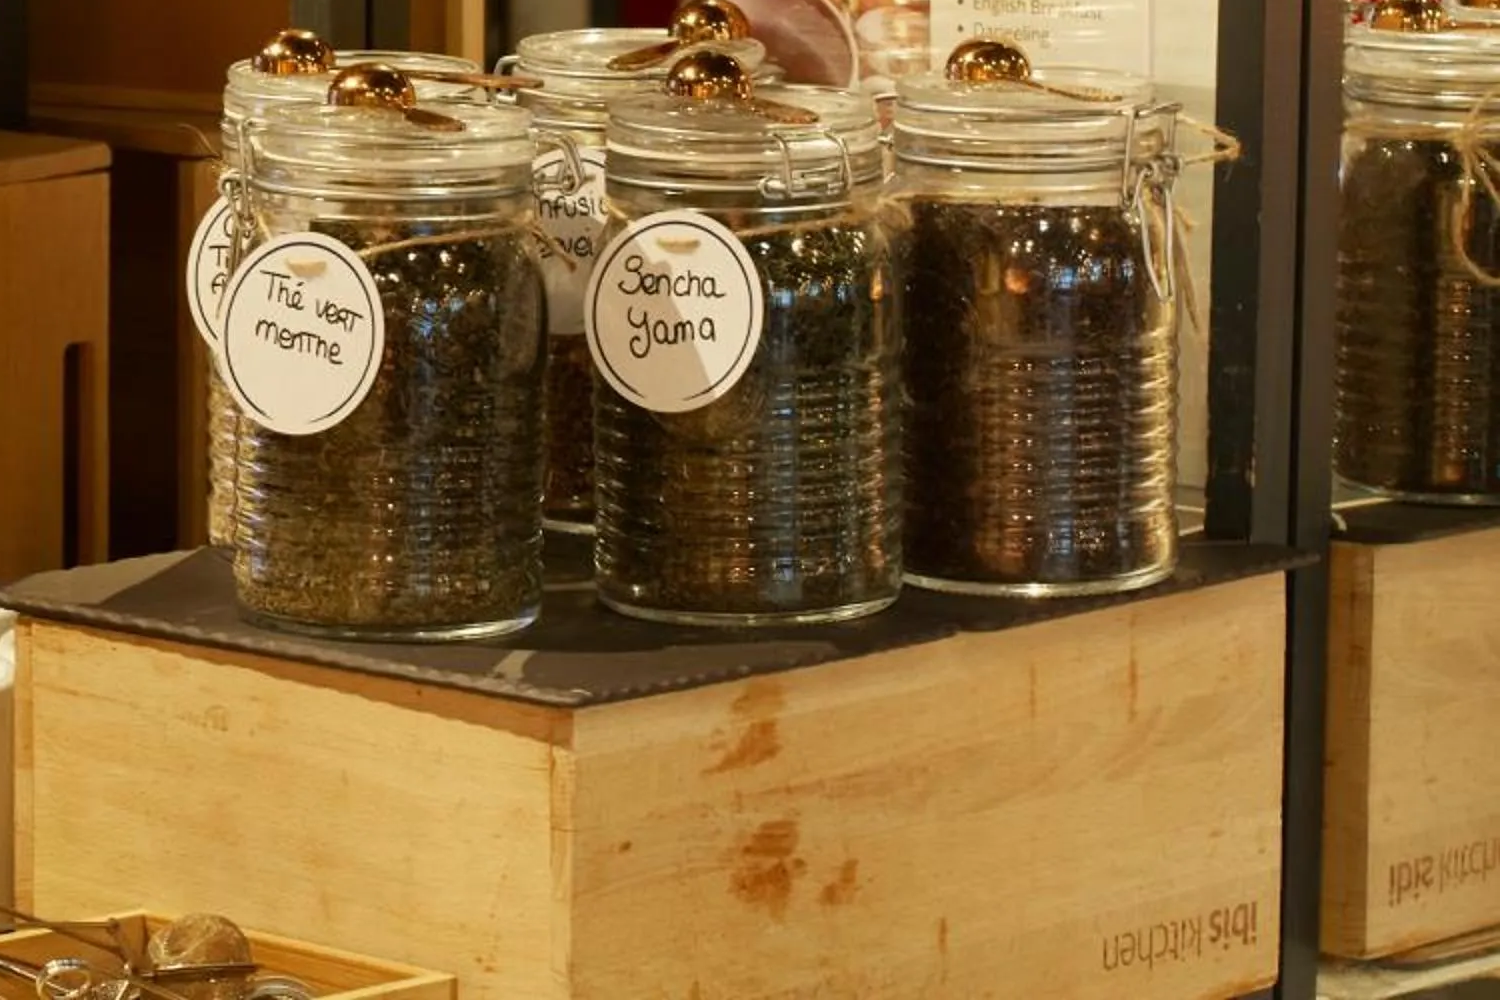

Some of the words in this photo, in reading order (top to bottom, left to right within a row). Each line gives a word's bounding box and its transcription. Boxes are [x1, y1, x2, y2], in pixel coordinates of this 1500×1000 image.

[259, 269, 306, 311] Thé
[617, 254, 727, 299] Sencha
[1102, 914, 1202, 972] kitchen
[1209, 900, 1258, 951] ibis
